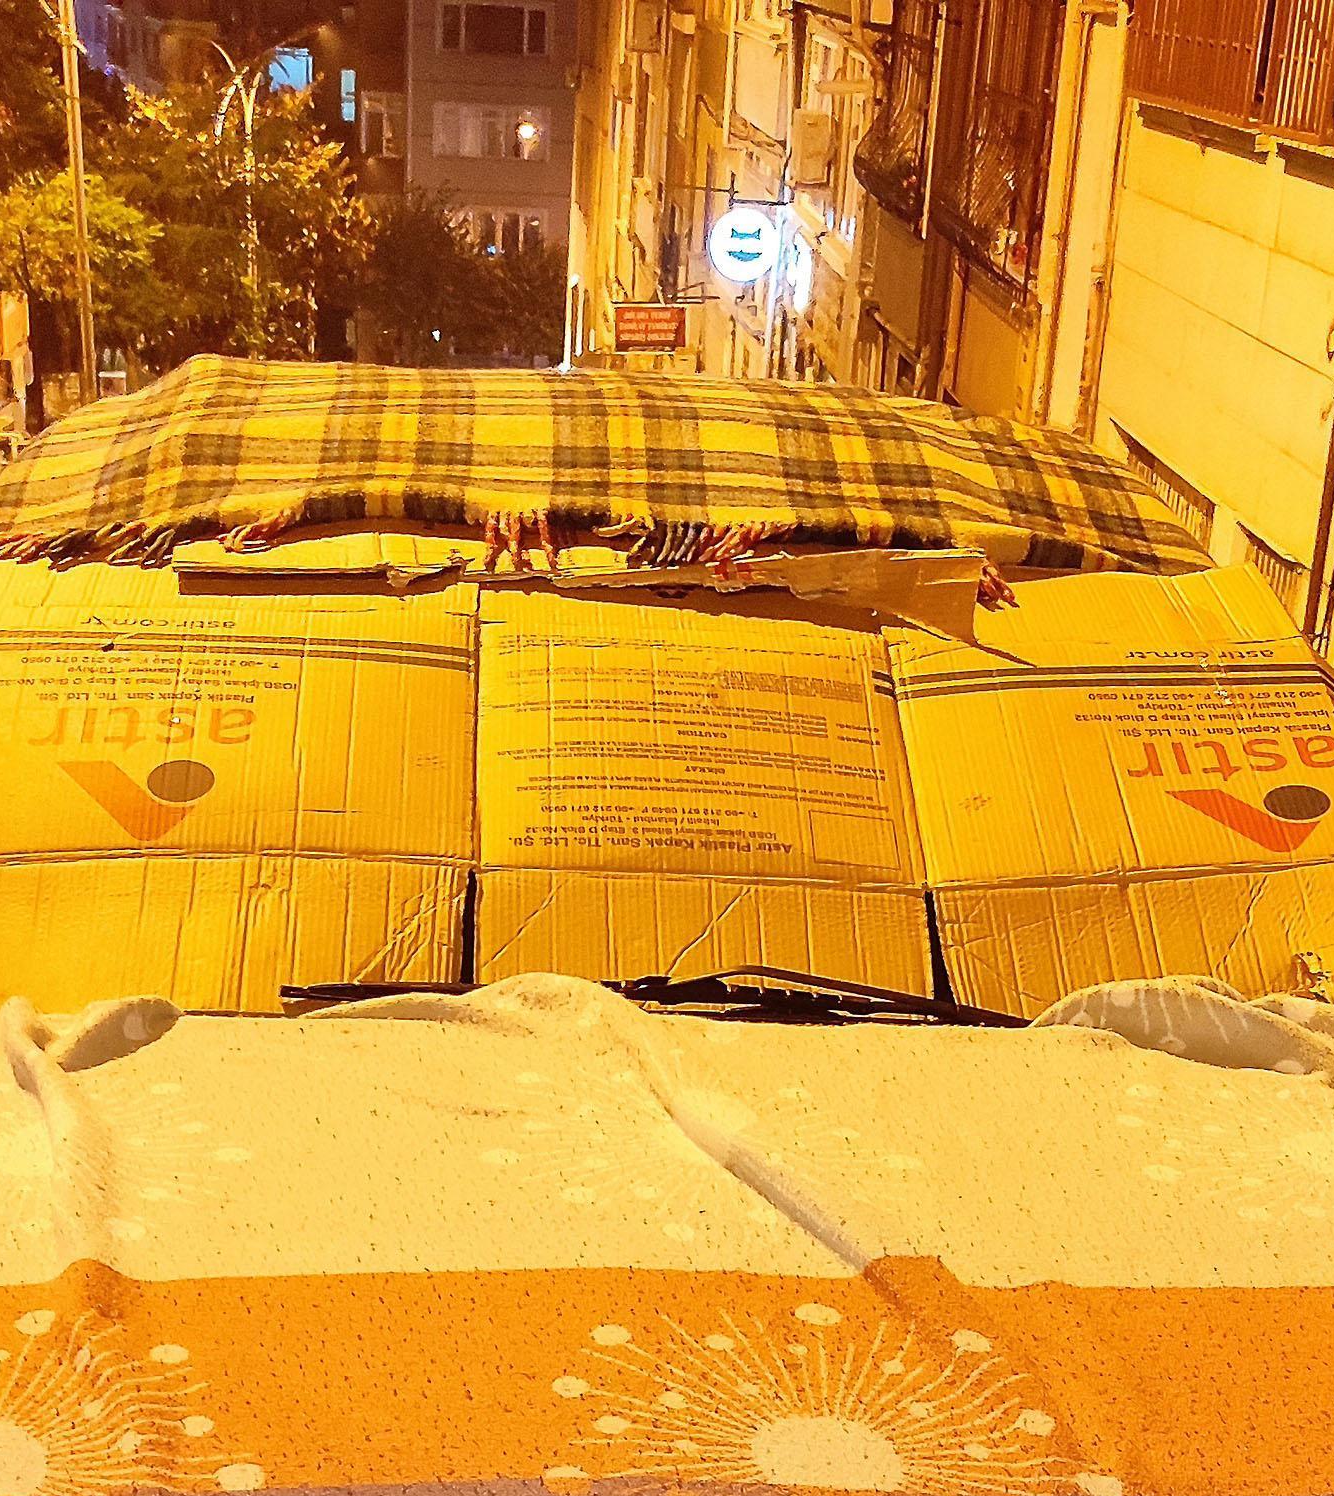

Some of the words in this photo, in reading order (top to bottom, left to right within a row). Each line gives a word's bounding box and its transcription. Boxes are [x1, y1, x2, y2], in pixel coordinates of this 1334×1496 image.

[208, 693, 254, 703] Plastik
[1237, 725, 1281, 735] Kapak
[540, 837, 568, 847] Ltd.
[574, 837, 601, 847] Tic.
[607, 837, 641, 848] San.
[644, 837, 695, 851] Kapak
[700, 840, 751, 853] Plastik
